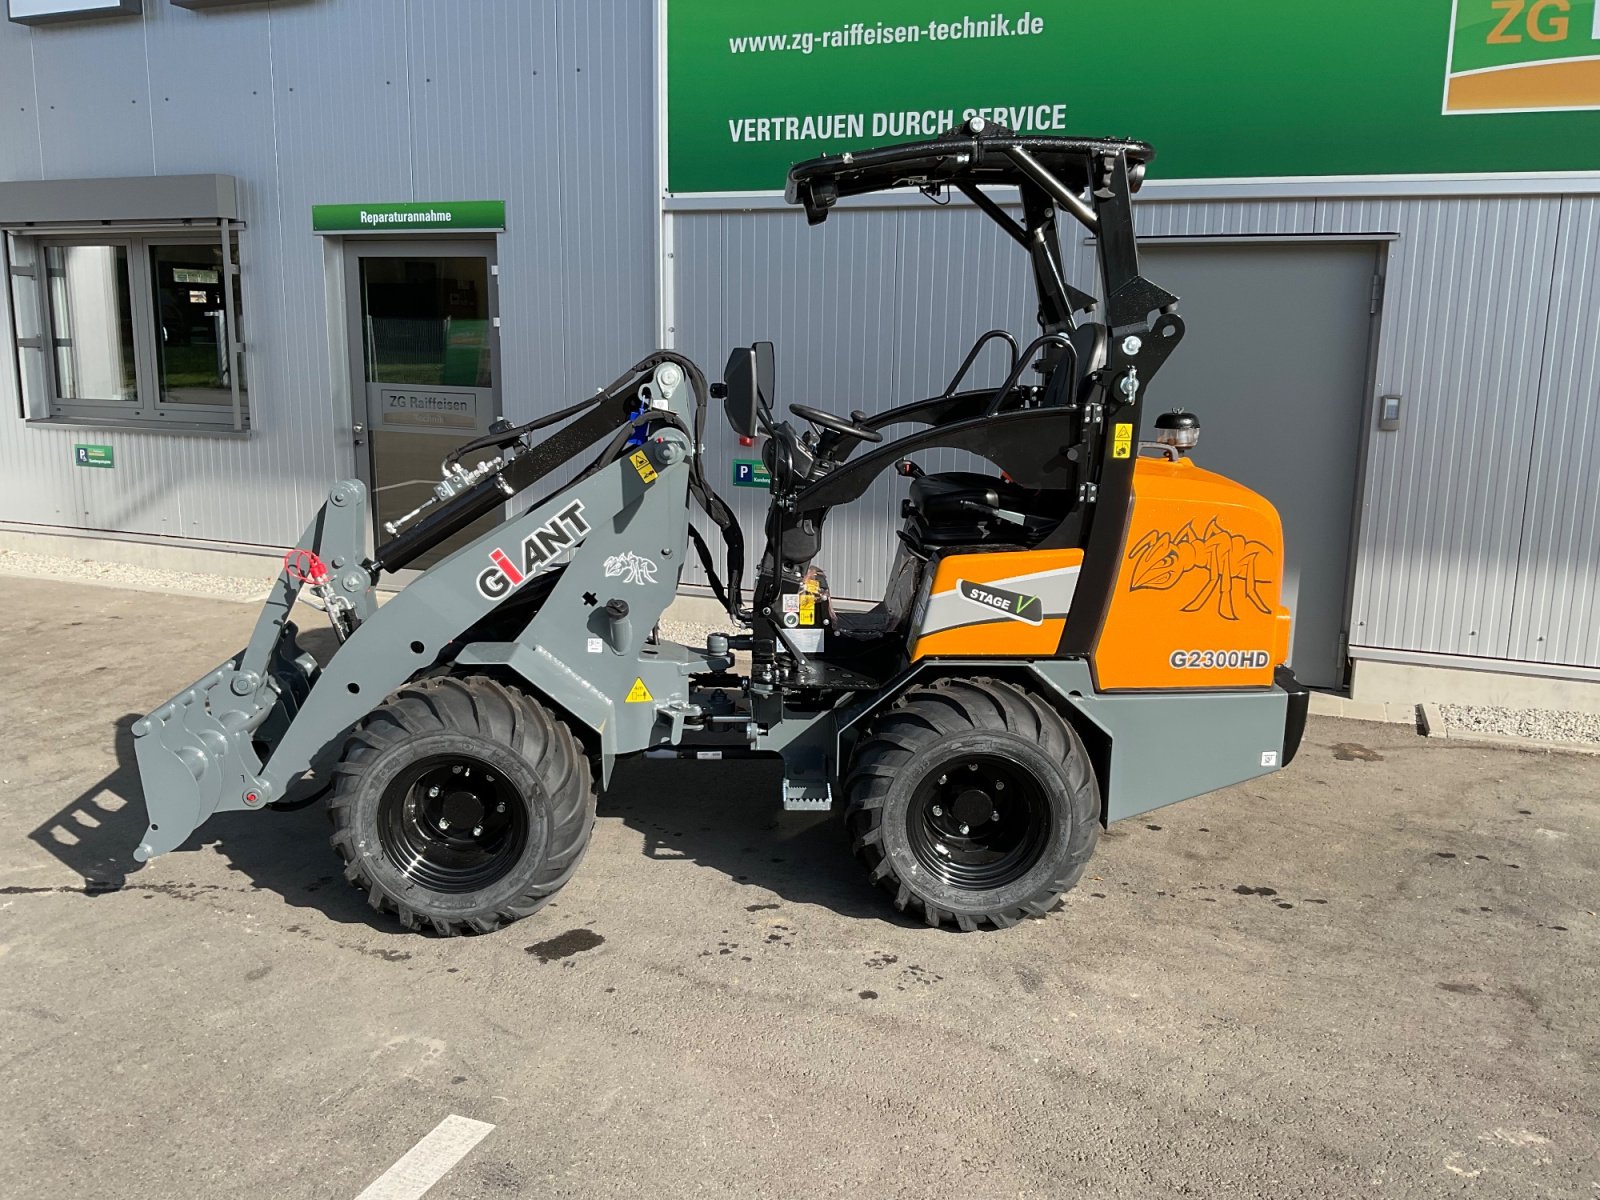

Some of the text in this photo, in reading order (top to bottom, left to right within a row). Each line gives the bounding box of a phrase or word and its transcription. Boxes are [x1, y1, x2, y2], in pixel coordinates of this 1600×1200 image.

[729, 12, 1044, 54] www.zg-raiffeisen-technik.de
[1486, 0, 1570, 44] ZG
[729, 114, 864, 142] VERTRAUEN
[872, 109, 953, 137] DURCH
[360, 209, 452, 226] Reparaturannahme
[389, 395, 467, 411] ZG Raiffeisen
[740, 465, 748, 478] P
[970, 588, 1037, 614] STAGE V
[1170, 650, 1269, 669] G2300HD
